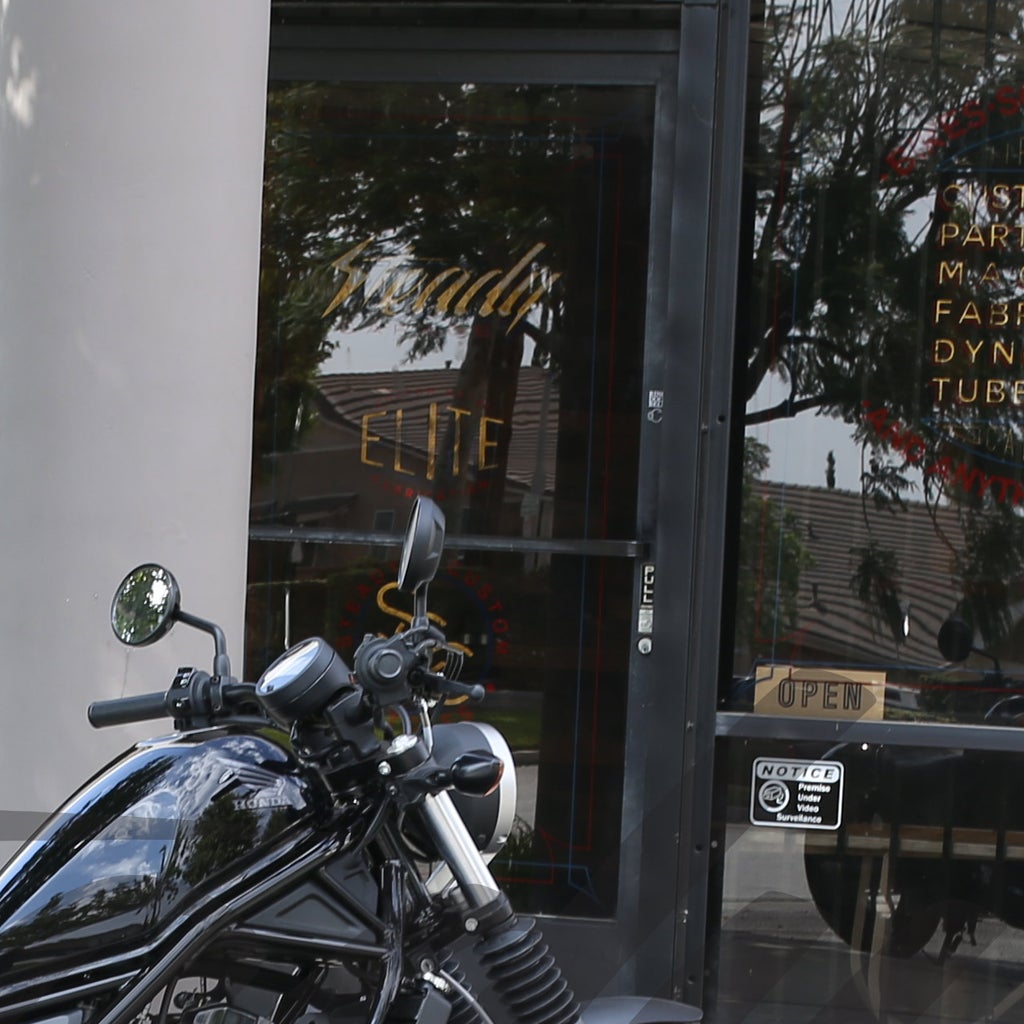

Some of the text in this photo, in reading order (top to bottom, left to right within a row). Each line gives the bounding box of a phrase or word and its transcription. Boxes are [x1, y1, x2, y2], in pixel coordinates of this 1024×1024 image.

[360, 401, 505, 481] ELITE
[642, 564, 656, 604] PULL
[778, 678, 863, 711] OPEN
[761, 766, 836, 780] NOTICE
[798, 783, 831, 793] Premise
[232, 797, 292, 811] HONDA
[797, 793, 821, 803] Under
[796, 803, 819, 813] Video
